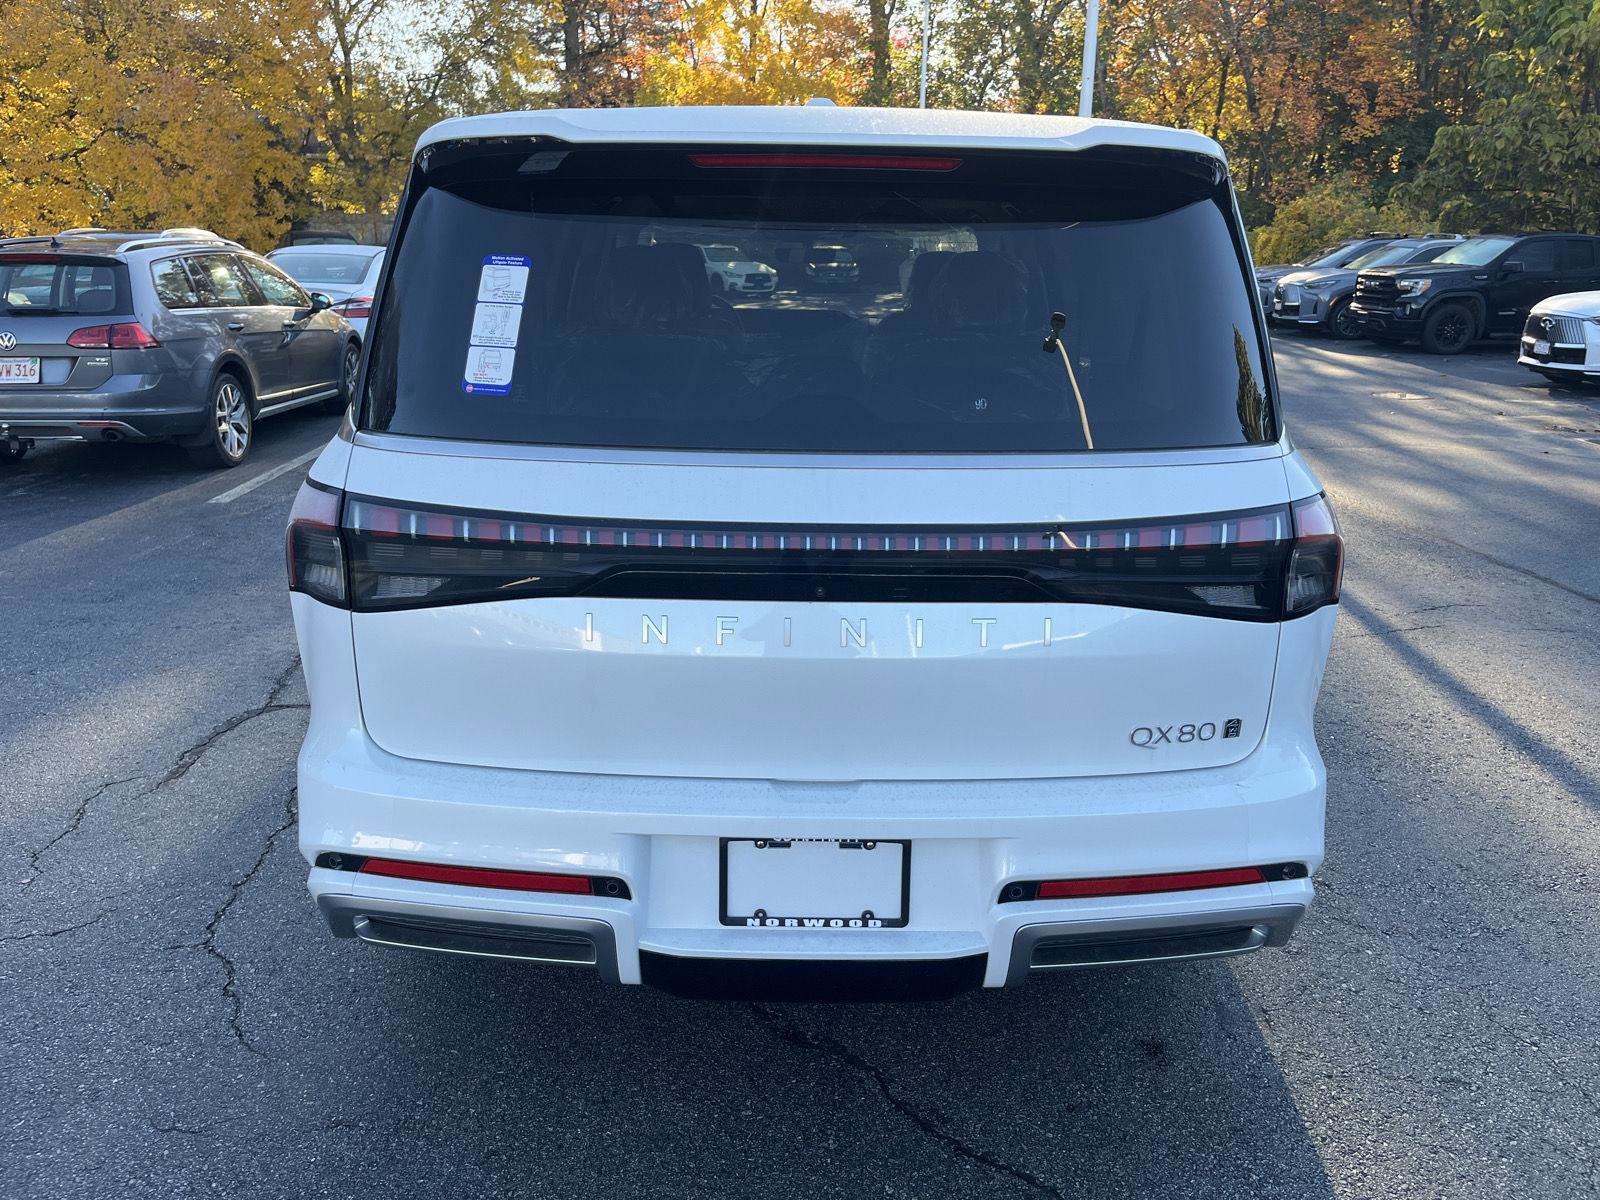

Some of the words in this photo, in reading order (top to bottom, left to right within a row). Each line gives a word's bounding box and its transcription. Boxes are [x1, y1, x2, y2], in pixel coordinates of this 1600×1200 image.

[15, 364, 36, 377] 316
[585, 612, 1052, 648] INFINITI
[1130, 722, 1216, 749] QX80
[746, 917, 882, 929] NORWOOD
